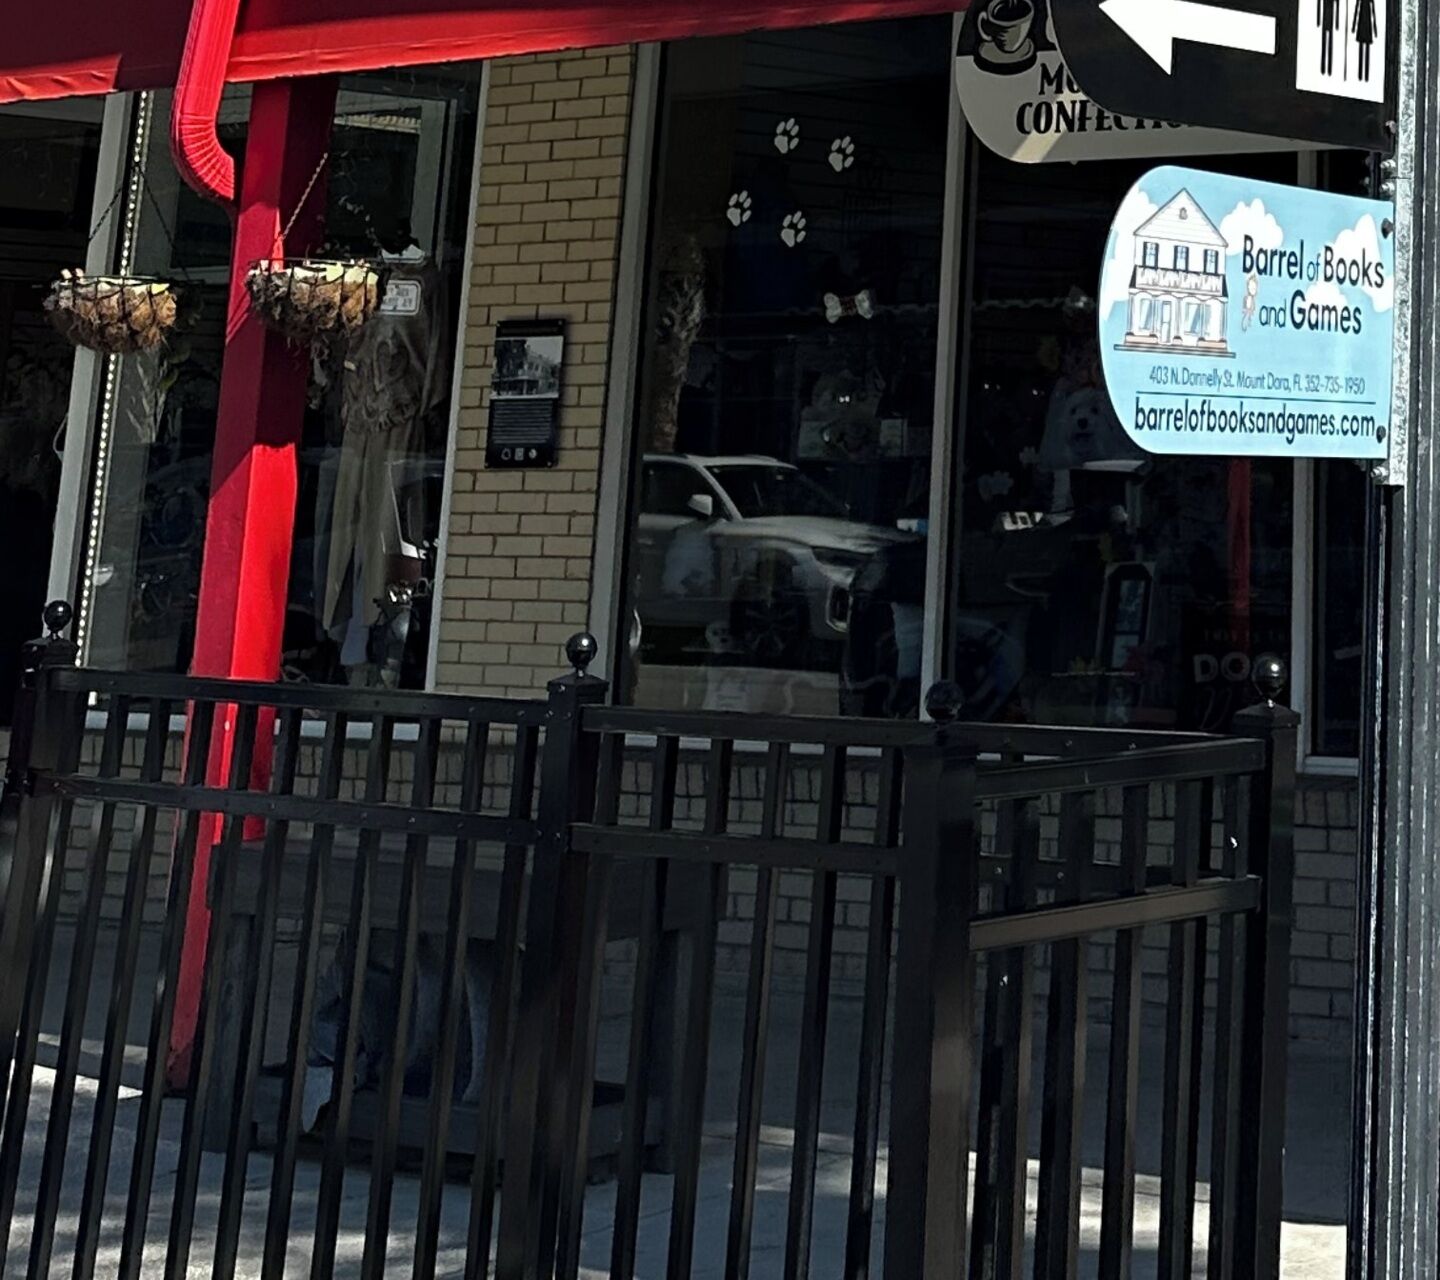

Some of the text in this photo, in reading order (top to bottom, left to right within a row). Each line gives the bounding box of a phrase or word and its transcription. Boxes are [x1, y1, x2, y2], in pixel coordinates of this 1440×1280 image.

[1242, 234, 1385, 289] Barrel of Books
[1258, 289, 1362, 335] and Games
[1149, 365, 1169, 386] 403
[1182, 367, 1223, 392] Donnelly
[1236, 371, 1266, 391] Mount
[1134, 396, 1376, 444] barrelofbooksandgames.com
